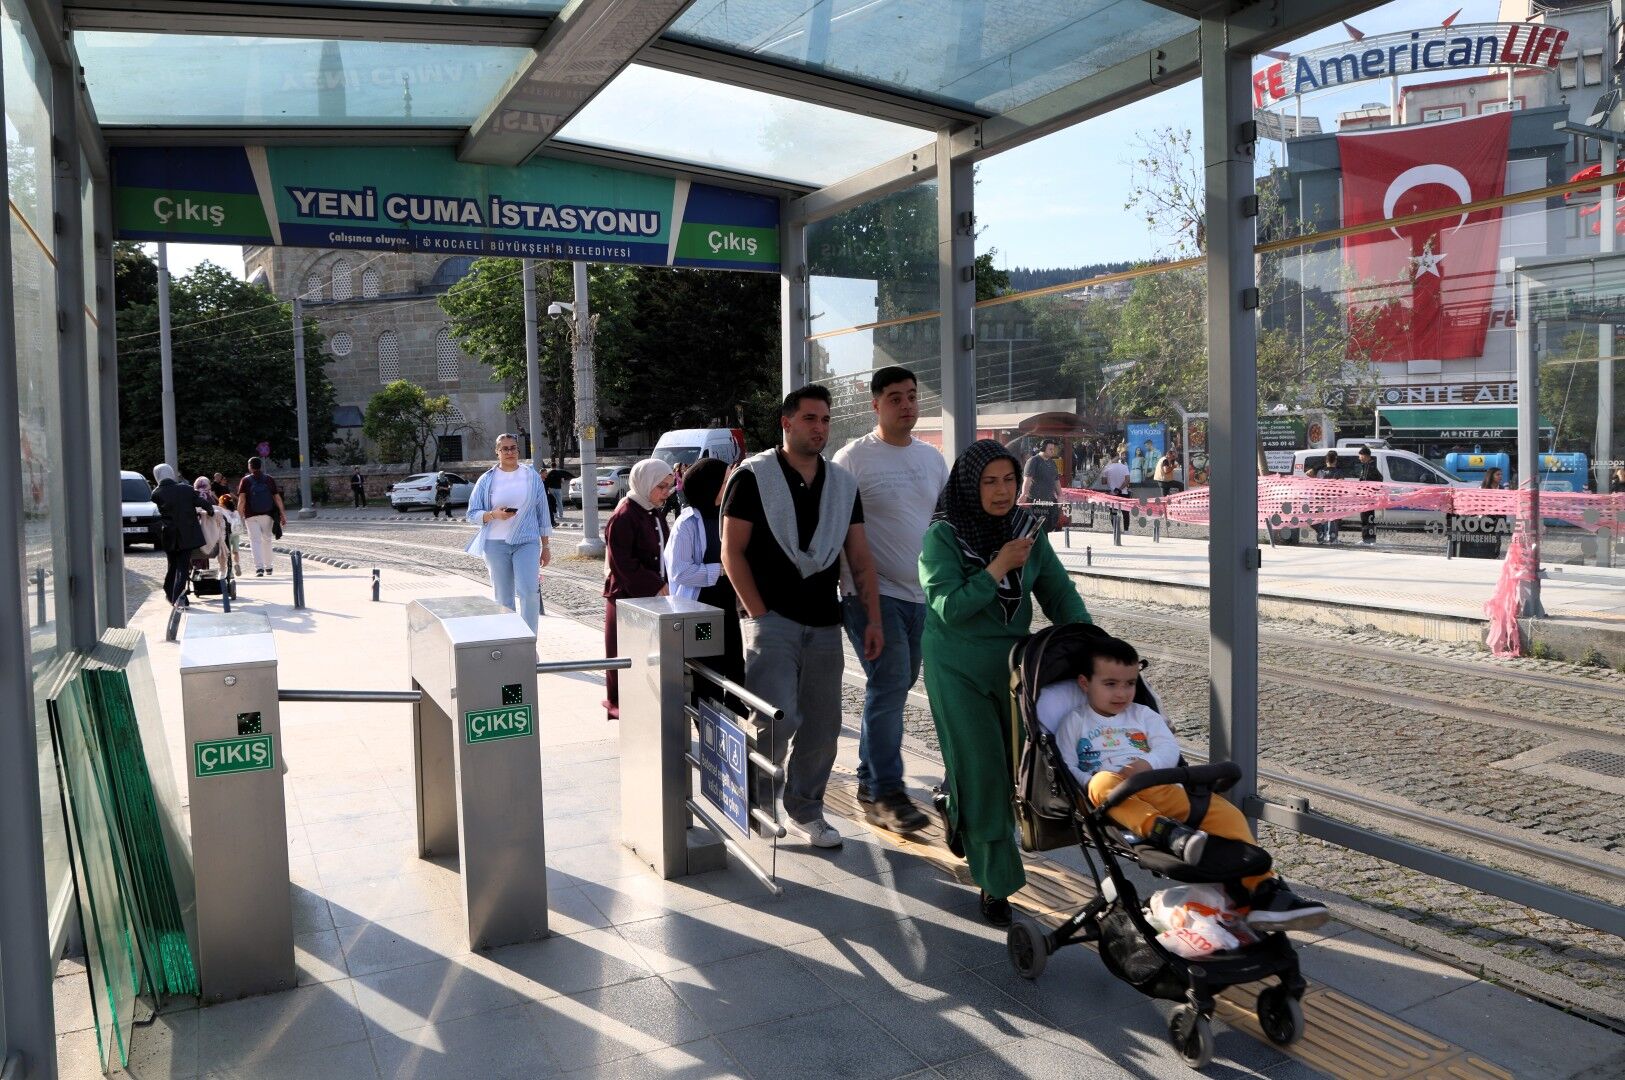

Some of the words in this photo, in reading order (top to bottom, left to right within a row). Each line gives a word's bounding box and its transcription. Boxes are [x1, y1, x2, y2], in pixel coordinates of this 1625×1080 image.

[154, 197, 225, 227] Çıkış
[292, 189, 375, 218] YENİ
[386, 196, 482, 224] CUMA
[492, 198, 658, 234] İSTASYONU
[328, 232, 373, 244] Çalışınca
[434, 238, 484, 250] KOCAELİ
[490, 240, 562, 255] BÜYÜKŞEHİR
[568, 245, 631, 258] BELEDİYESİ
[708, 230, 758, 256] Çıkış
[1440, 430, 1479, 438] MONTE
[471, 711, 528, 738] ÇIKIŞ
[201, 742, 268, 771] ÇIKIŞ
